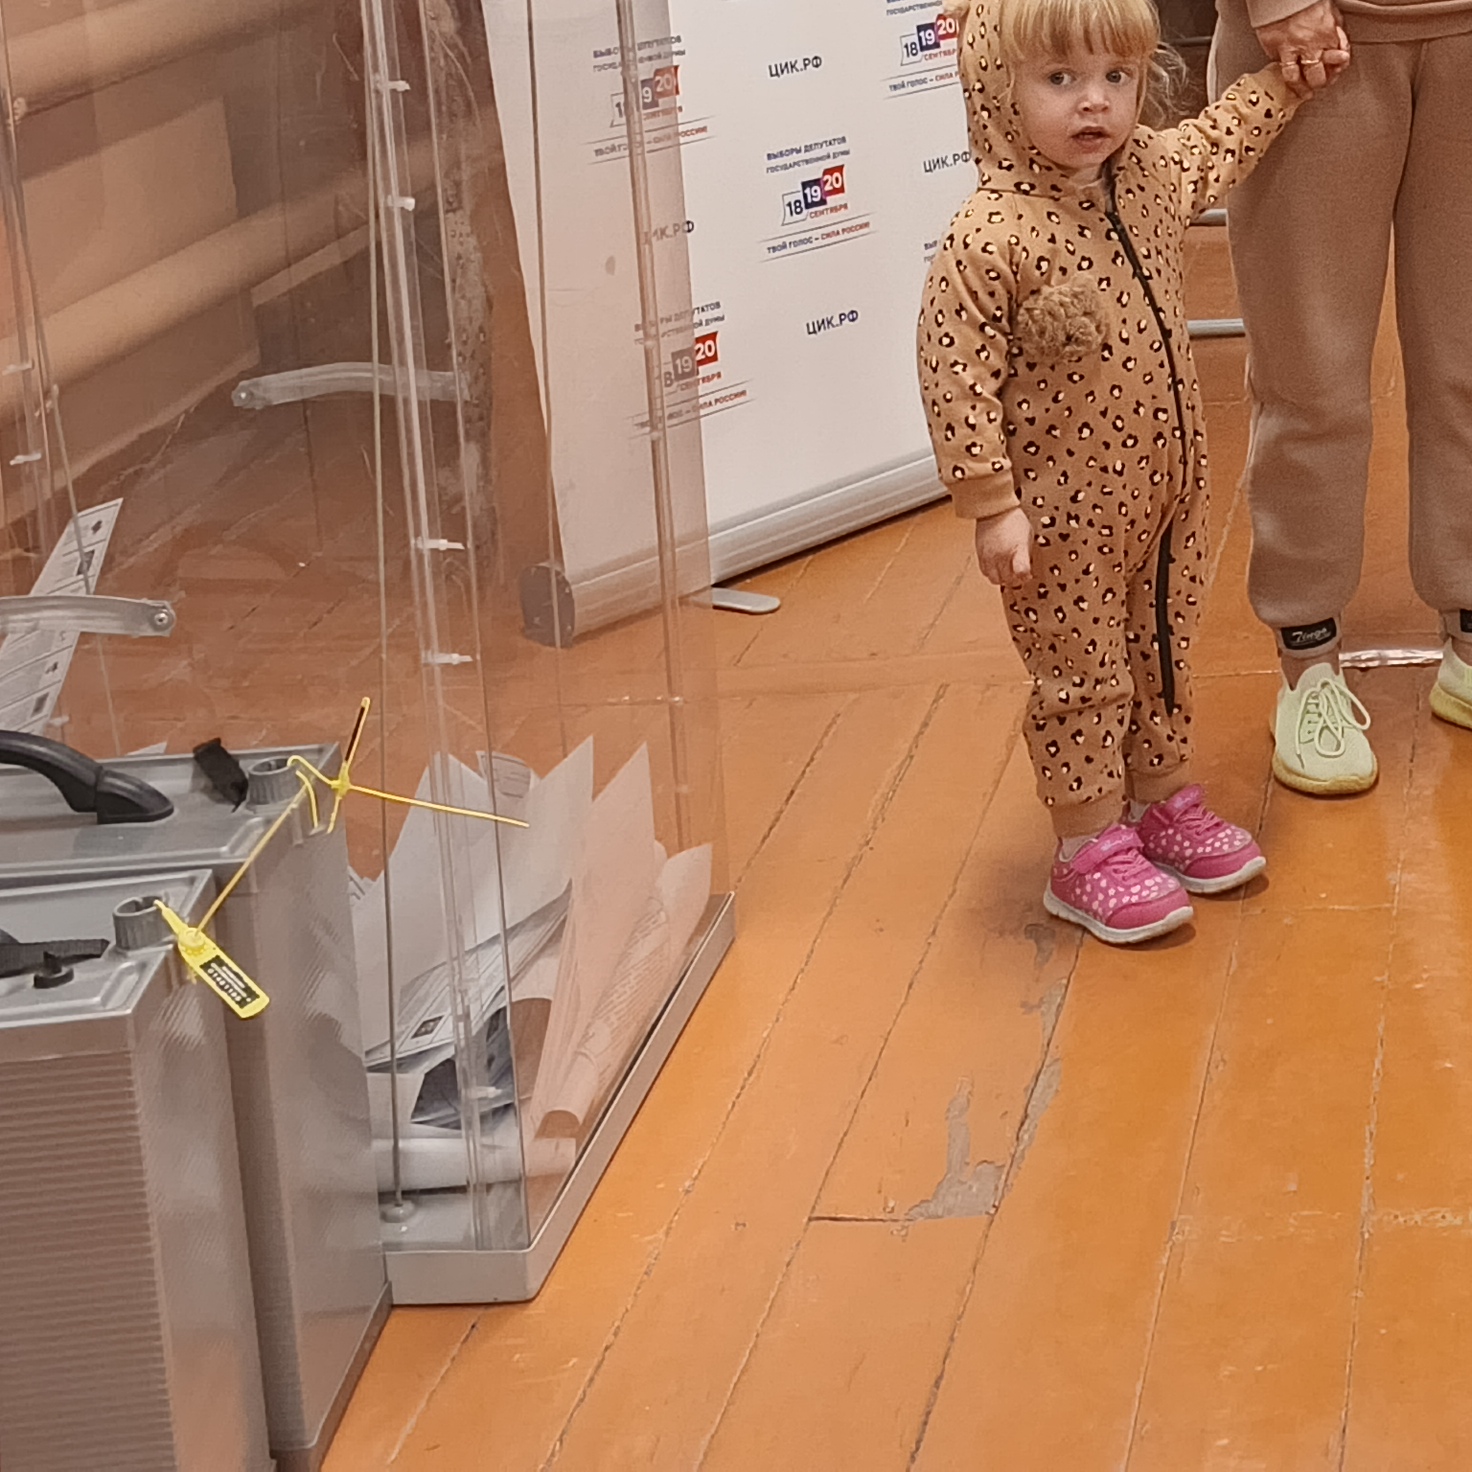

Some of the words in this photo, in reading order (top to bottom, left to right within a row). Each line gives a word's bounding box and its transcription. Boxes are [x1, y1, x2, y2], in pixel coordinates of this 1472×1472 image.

[904, 42, 918, 58] 18
[919, 29, 935, 46] 19
[937, 18, 955, 35] 20
[768, 56, 822, 78] ЦИК.РФ
[924, 48, 956, 61] СЕНТЯБР
[923, 151, 972, 173] ЦИК.РФ
[786, 199, 803, 217] 18
[804, 186, 821, 203] 19
[823, 172, 842, 191] 20
[806, 309, 859, 336] ЦИК.РФ
[675, 356, 692, 374] 19
[694, 340, 715, 360] 20
